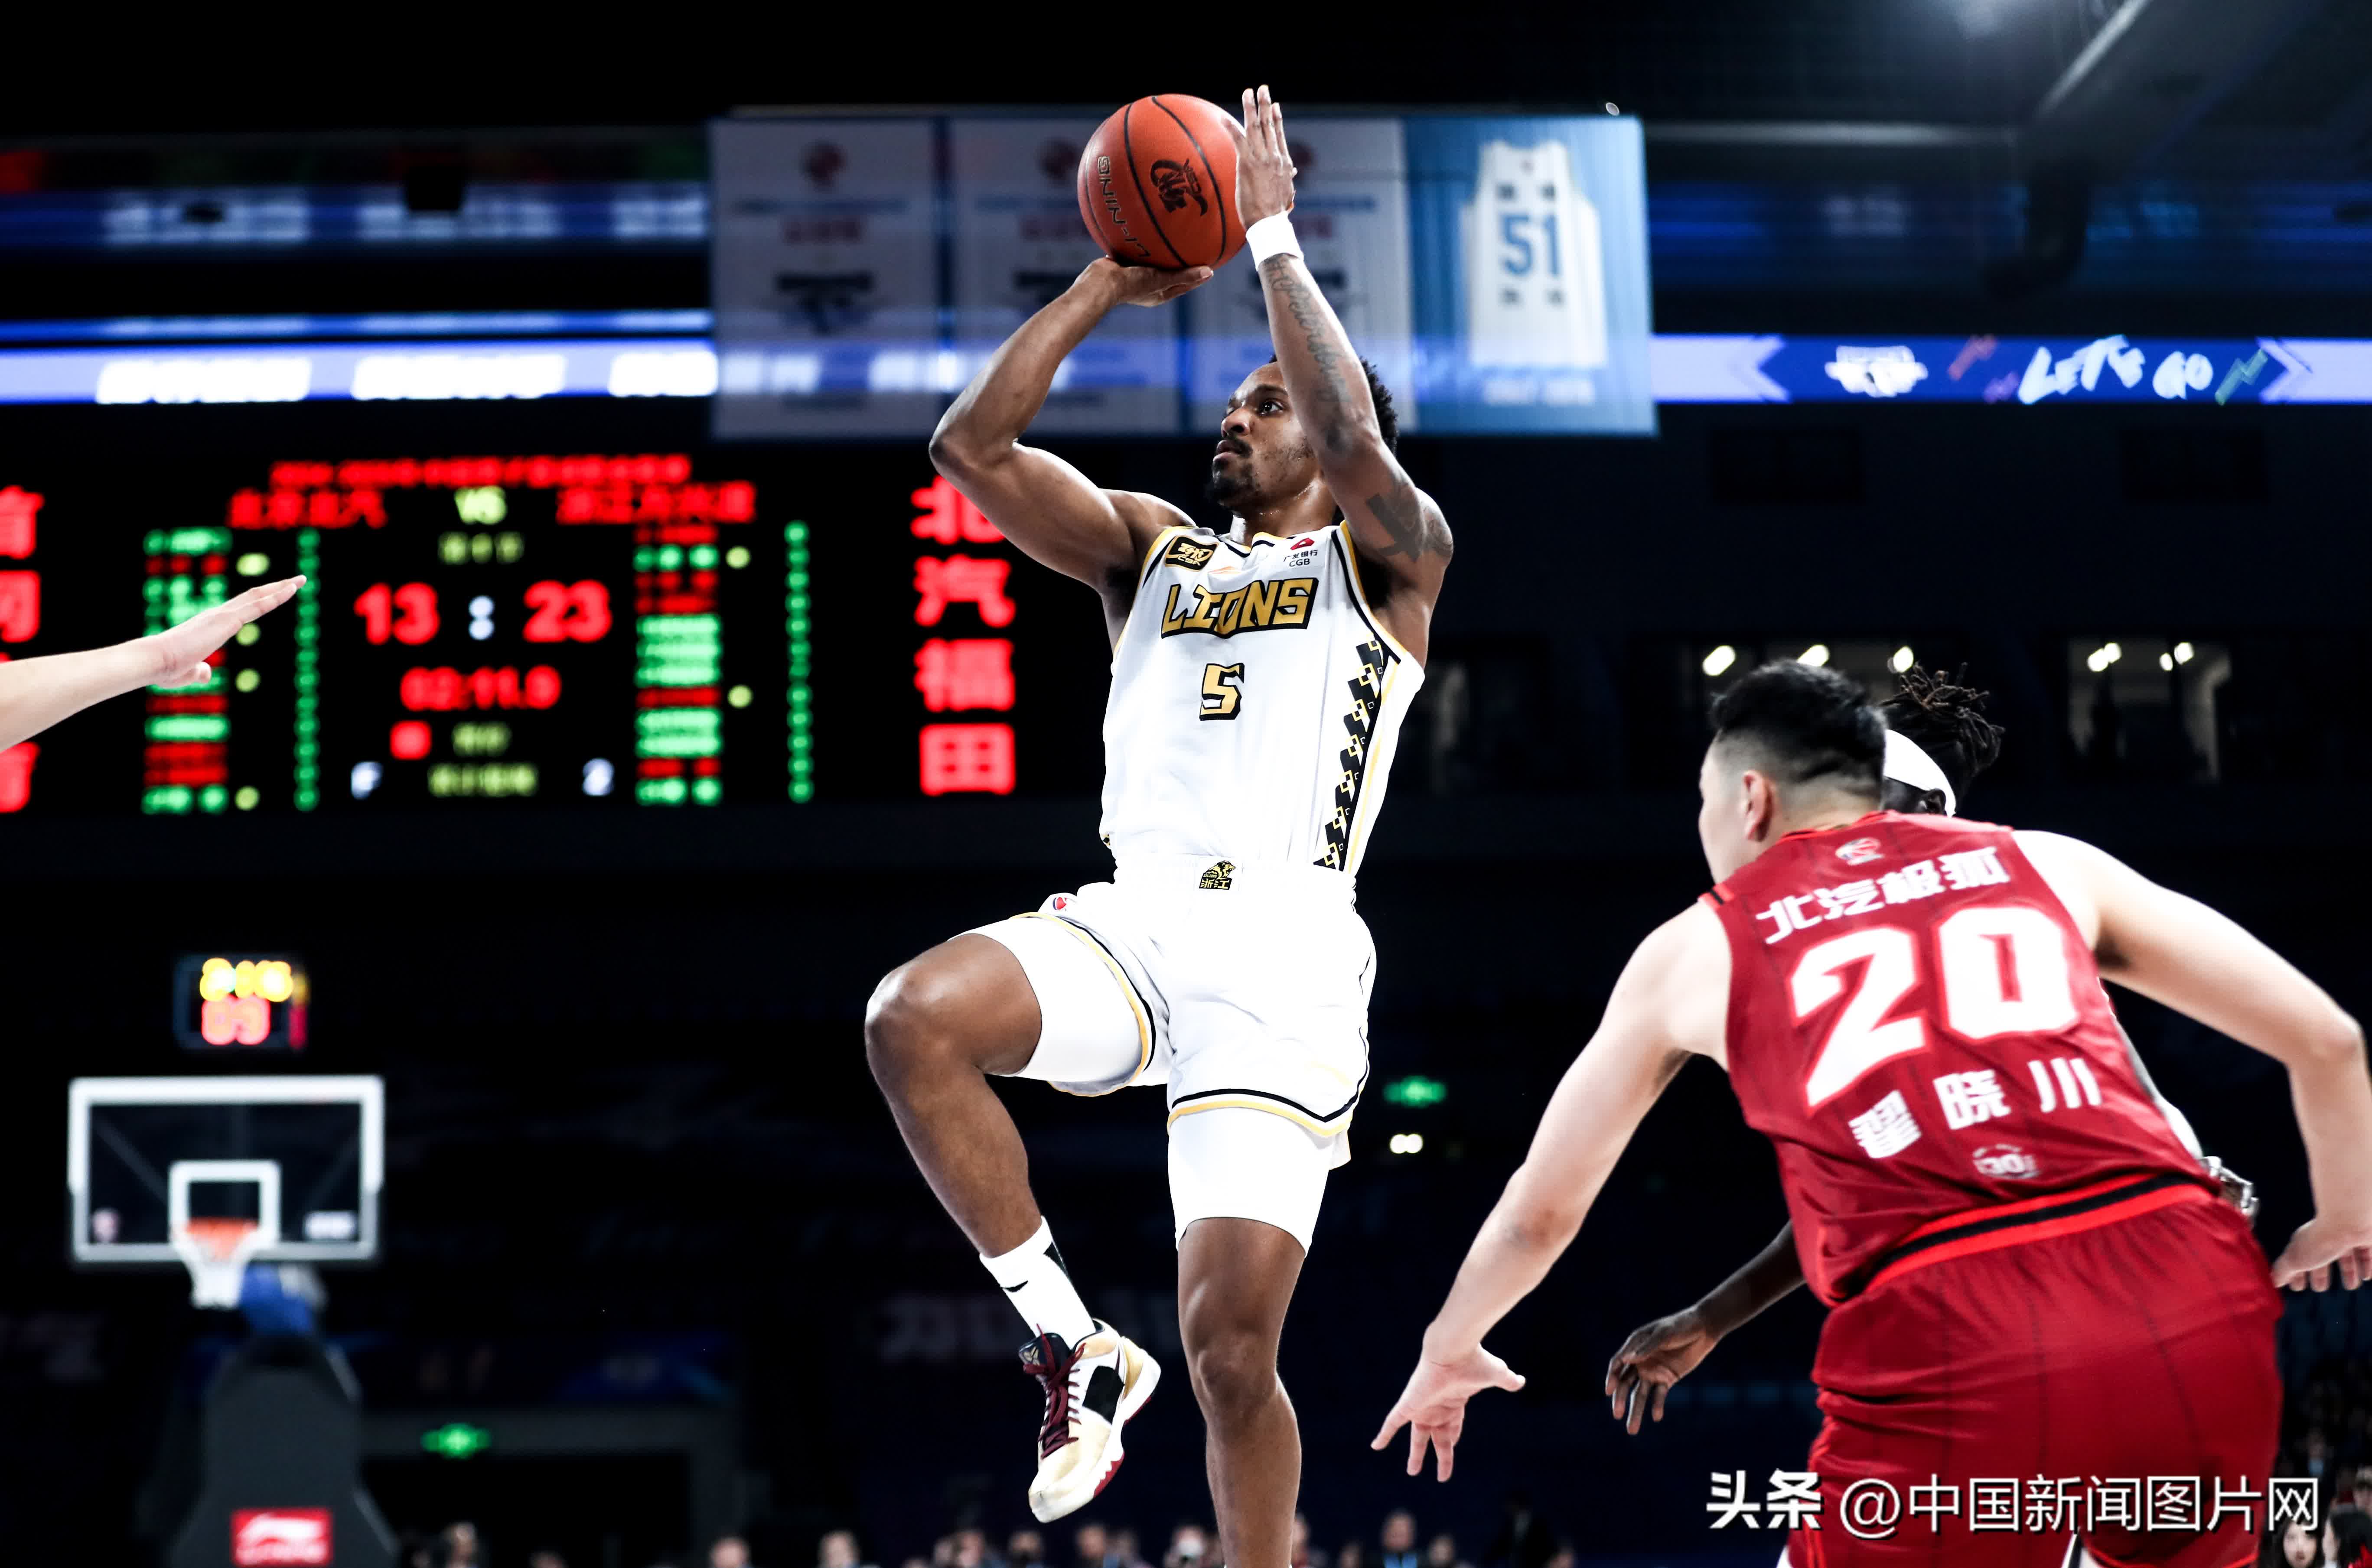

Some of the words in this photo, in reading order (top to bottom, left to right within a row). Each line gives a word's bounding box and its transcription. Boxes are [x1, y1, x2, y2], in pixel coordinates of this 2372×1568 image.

[1098, 156, 1151, 257] LI-NING
[1499, 213, 1561, 277] 51
[2153, 351, 2214, 400] GO
[1177, 555, 1199, 566] CBA
[1283, 550, 1318, 562] 广发银行
[1289, 558, 1310, 567] CGB
[354, 582, 440, 645] 13
[522, 579, 613, 643] 23
[1161, 577, 1319, 639] LIONS
[1199, 663, 1244, 721] 5
[1200, 878, 1230, 889] 浙江
[1755, 846, 2010, 945] 北汽极狐
[1789, 907, 2080, 1109] 20
